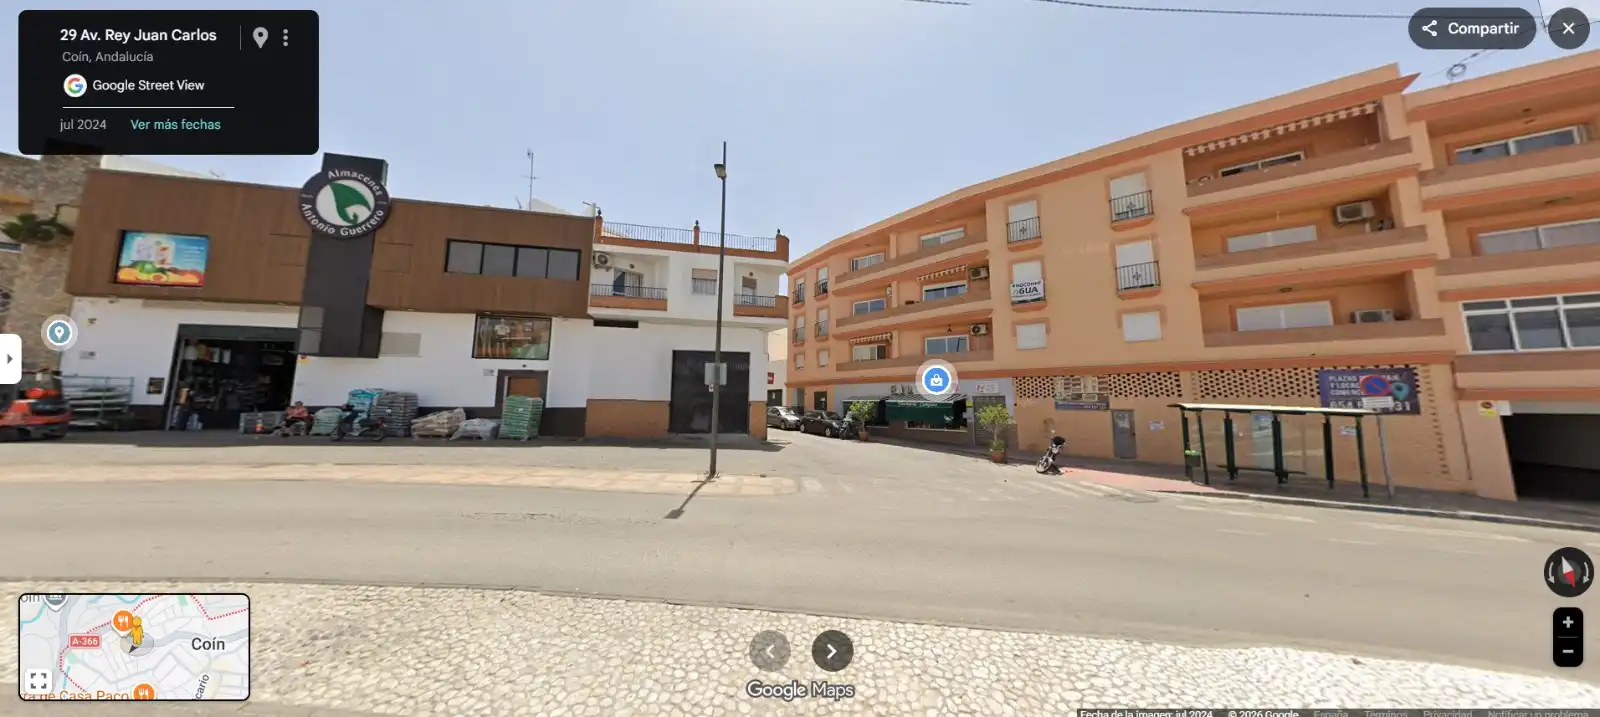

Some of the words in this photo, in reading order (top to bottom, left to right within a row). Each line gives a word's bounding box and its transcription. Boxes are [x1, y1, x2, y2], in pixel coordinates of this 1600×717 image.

[328, 169, 383, 196] Almacenes
[301, 203, 336, 234] Antonio
[340, 210, 384, 236] Guerrero
